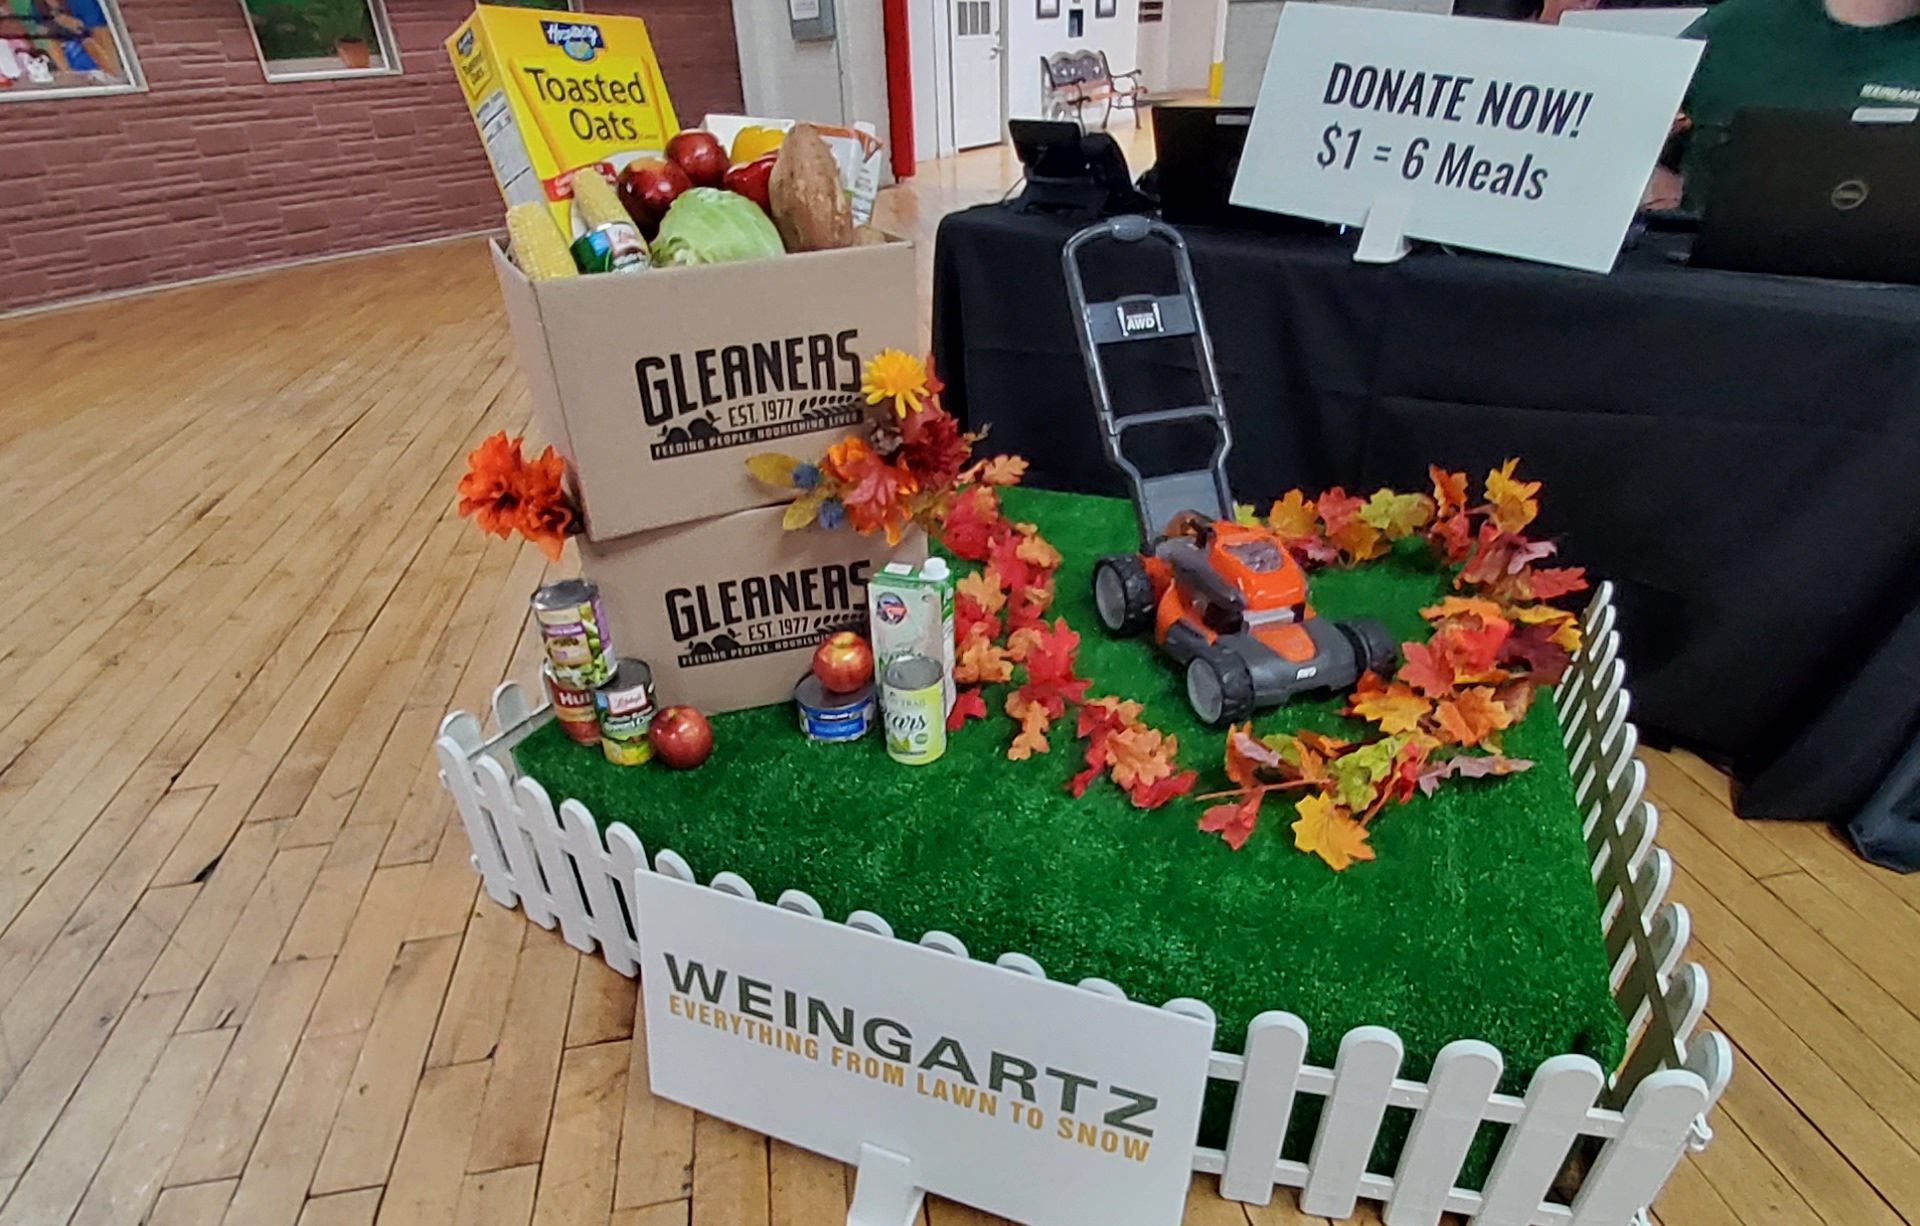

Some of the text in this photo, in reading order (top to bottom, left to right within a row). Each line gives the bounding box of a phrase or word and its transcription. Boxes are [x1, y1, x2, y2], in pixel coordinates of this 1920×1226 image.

[523, 67, 646, 104] Toasted
[569, 108, 637, 140] Oats
[1323, 61, 1594, 138] DONATE NOW!
[1316, 121, 1362, 170] $1
[1401, 137, 1430, 180] 6
[1434, 142, 1549, 200] Meals
[1126, 316, 1156, 331] AWD
[635, 329, 862, 427] GLEANERS
[727, 398, 794, 428] EST. 1977
[665, 560, 870, 642] GLEANERS
[748, 617, 808, 641] EST. 1977
[663, 952, 1158, 1138] WEINGARTZ
[669, 994, 1150, 1162] EVERYTHING FROM LAWN TO SNOW
